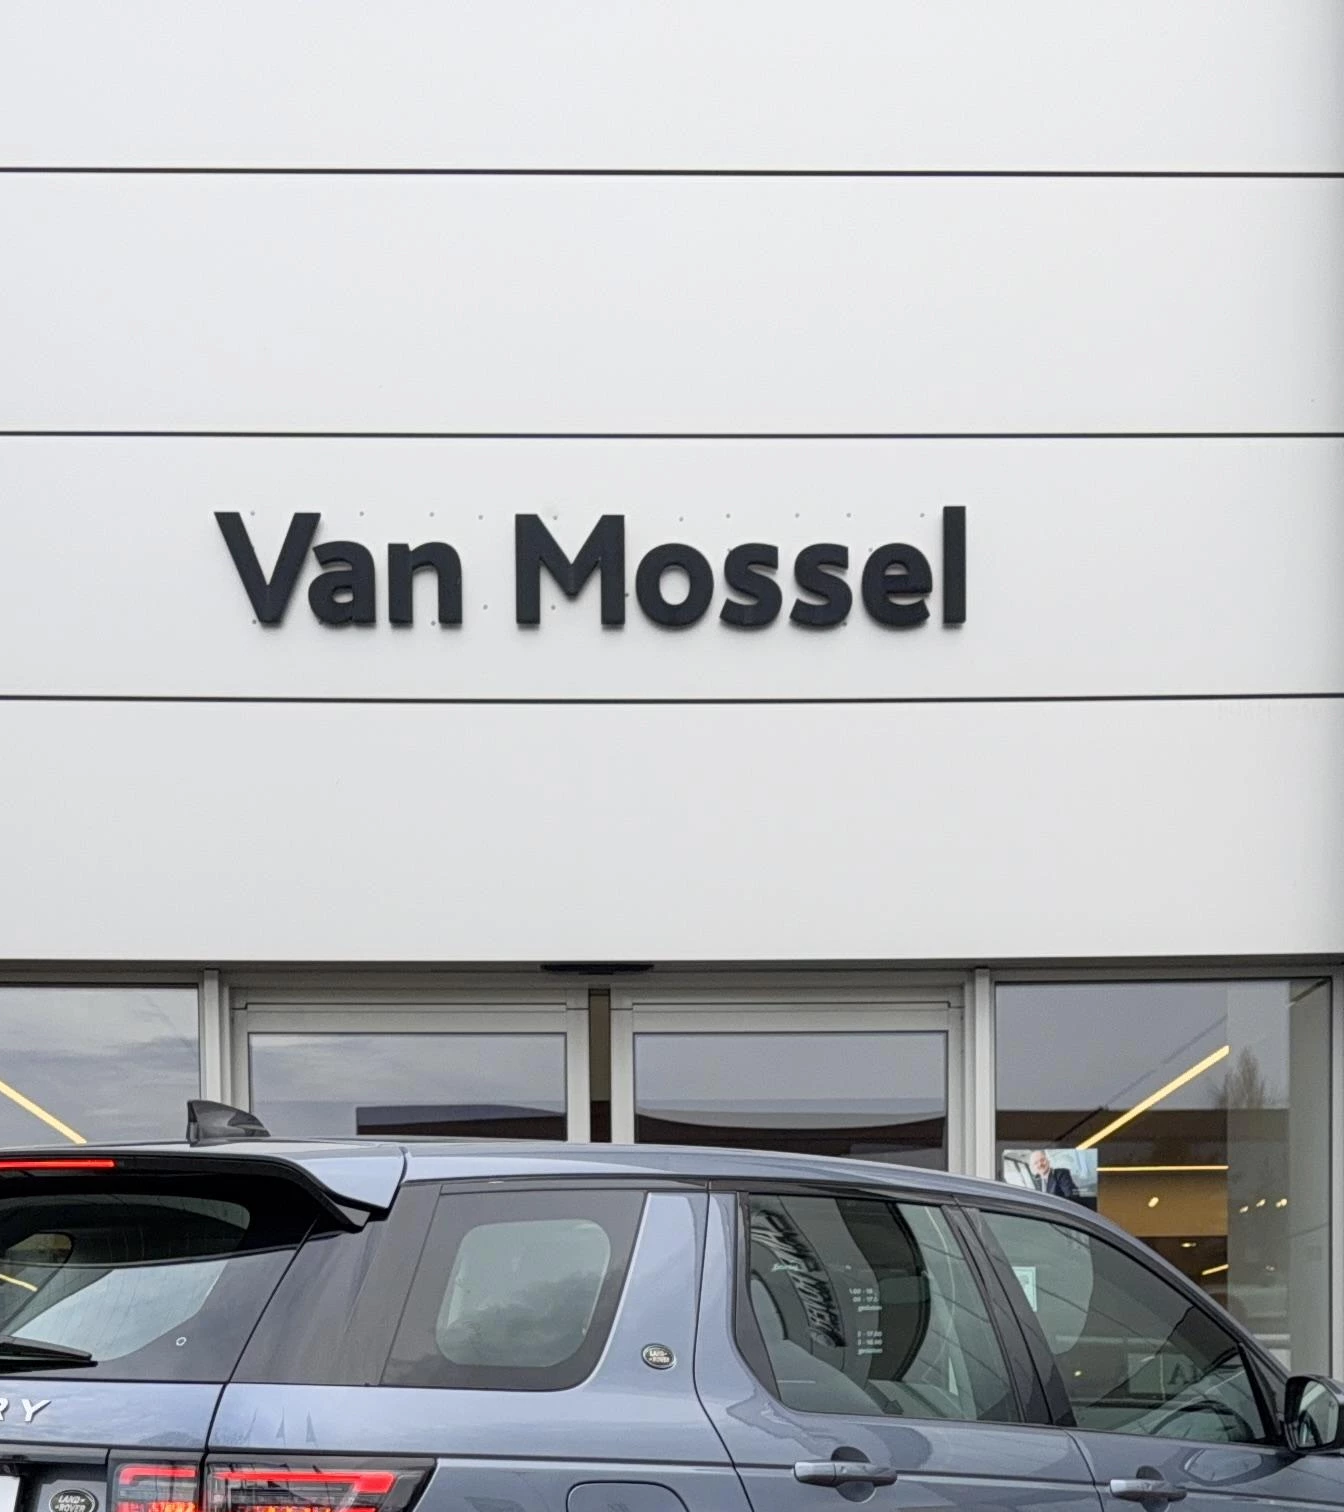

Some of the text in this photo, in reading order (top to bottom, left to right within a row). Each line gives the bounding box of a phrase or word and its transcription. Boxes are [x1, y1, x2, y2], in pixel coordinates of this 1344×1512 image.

[213, 505, 967, 629] Van Mossel
[58, 1494, 81, 1504] LAND
[58, 1503, 87, 1512] ROVER
